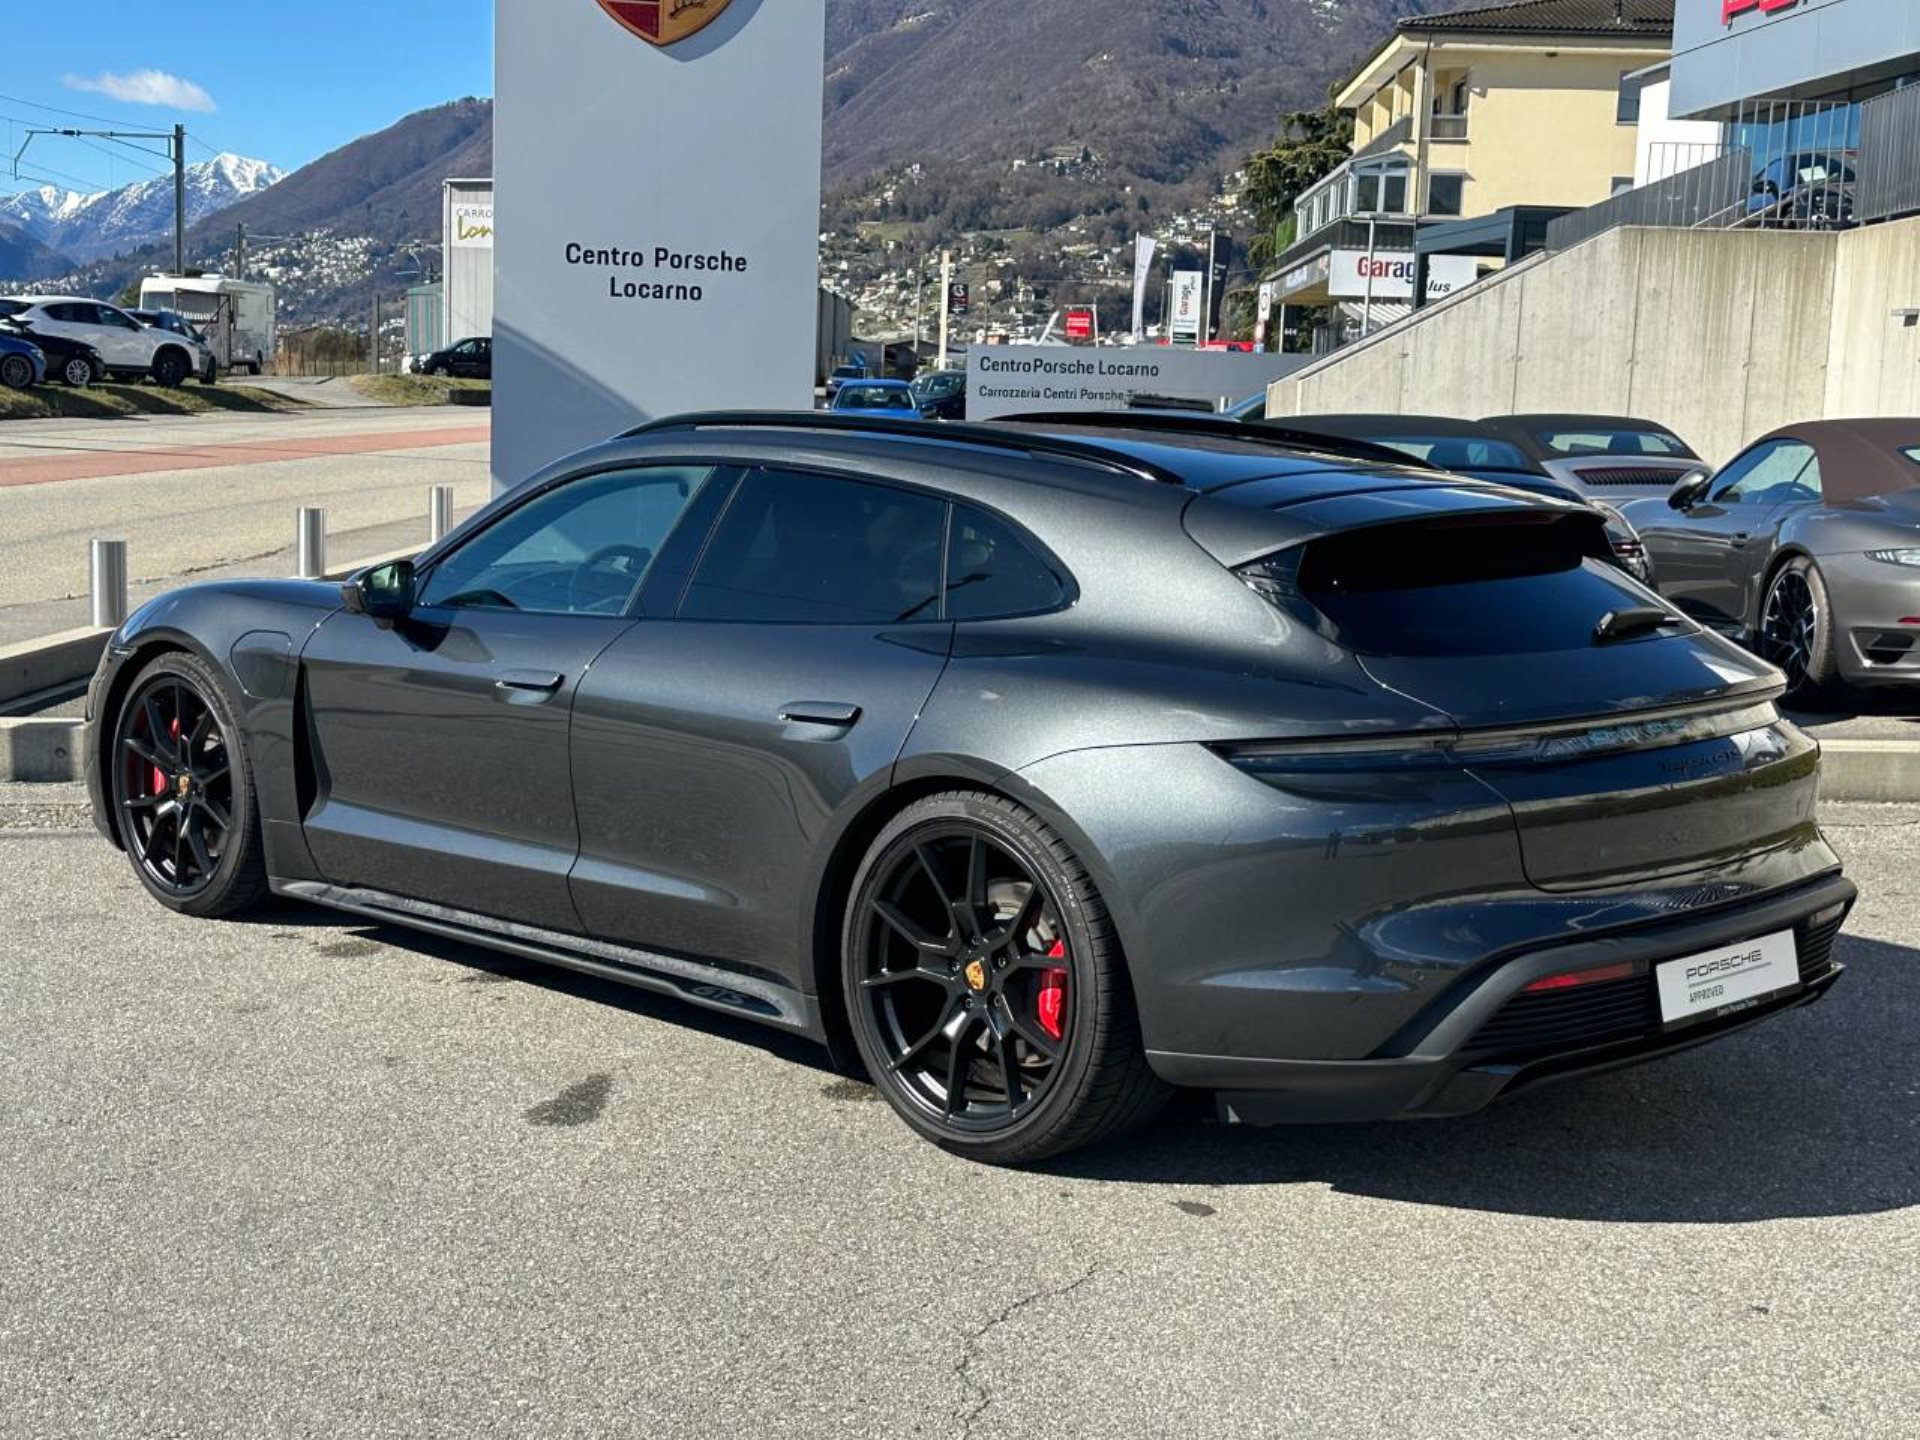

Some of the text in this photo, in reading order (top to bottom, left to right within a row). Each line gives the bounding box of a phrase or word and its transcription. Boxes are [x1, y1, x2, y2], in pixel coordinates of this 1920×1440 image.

[565, 242, 747, 272] Centro Porsche
[1356, 255, 1416, 284] Garag
[609, 275, 703, 301] Locarno
[1427, 279, 1452, 293] lus
[1098, 360, 1159, 377] Locarno
[979, 385, 1040, 399] Carrozzeria
[1043, 387, 1077, 399] Centri
[1080, 389, 1124, 401] Porsche
[1685, 949, 1762, 980] PORSCHE
[1689, 984, 1724, 1003] APPROVED
